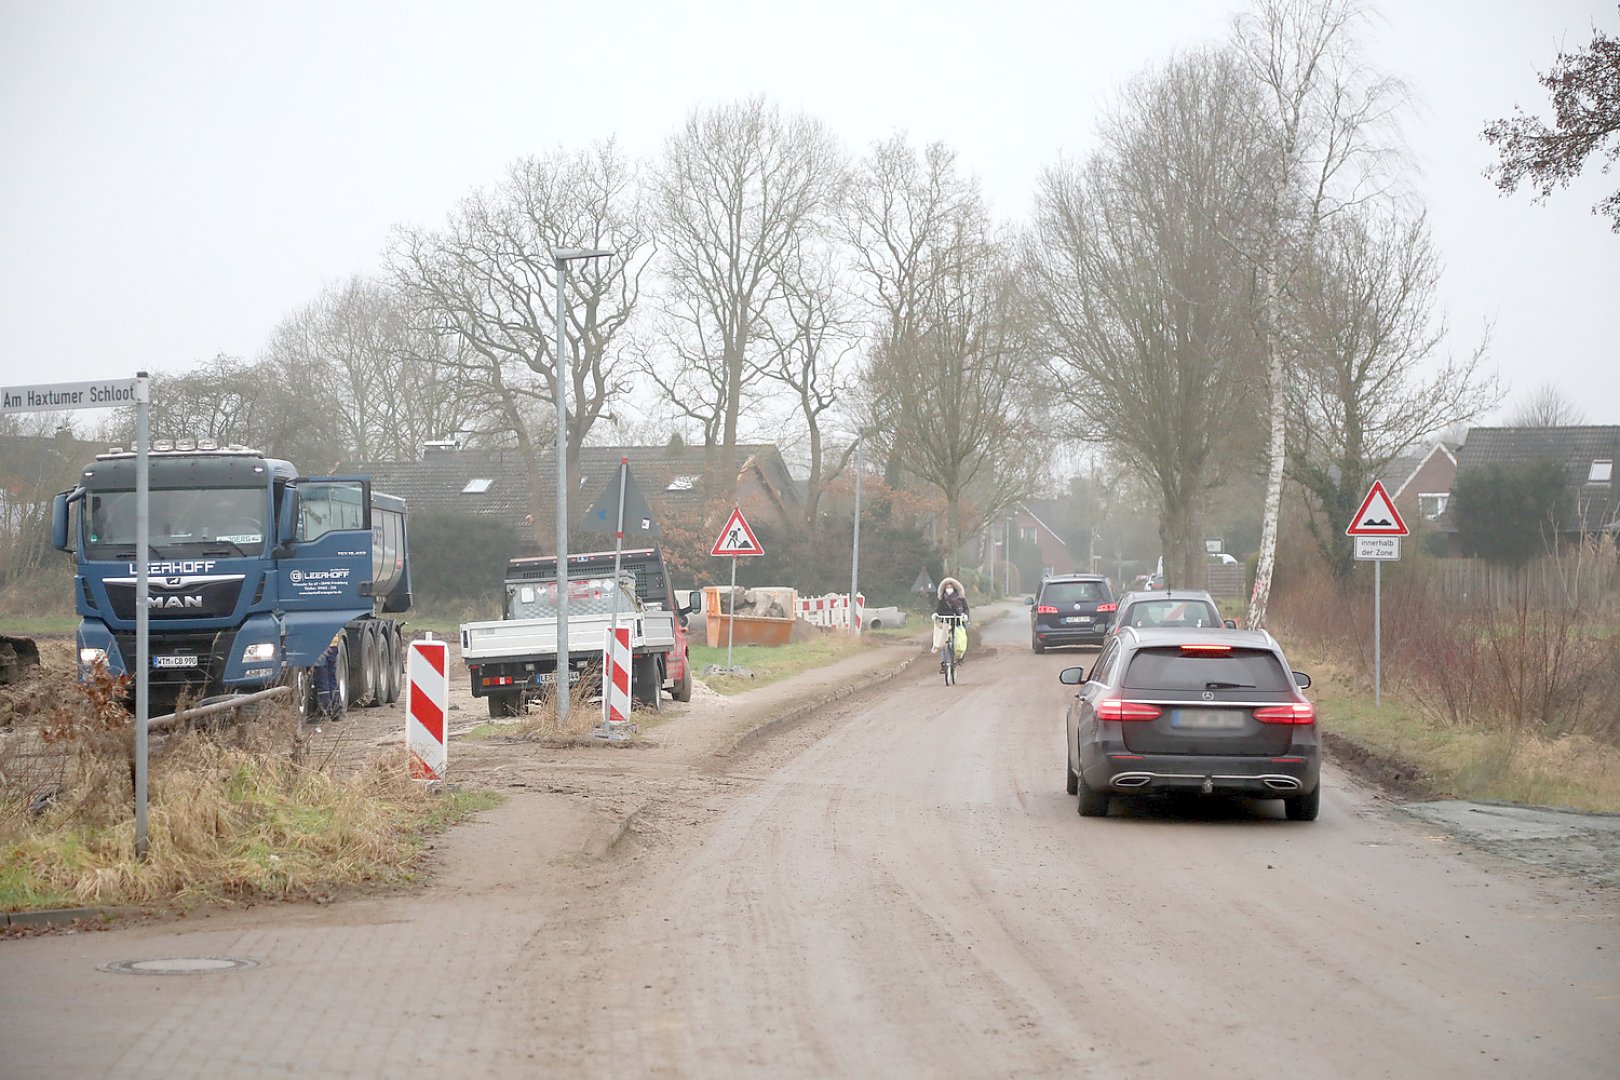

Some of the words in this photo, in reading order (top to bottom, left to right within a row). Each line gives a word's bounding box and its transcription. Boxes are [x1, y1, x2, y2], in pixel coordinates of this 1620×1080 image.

[3, 392, 22, 408] Am
[27, 390, 84, 406] Haxtumer
[90, 385, 135, 402] Schloot
[304, 571, 350, 580] LEERHOFF
[147, 595, 203, 609] MAN
[174, 657, 184, 665] CB
